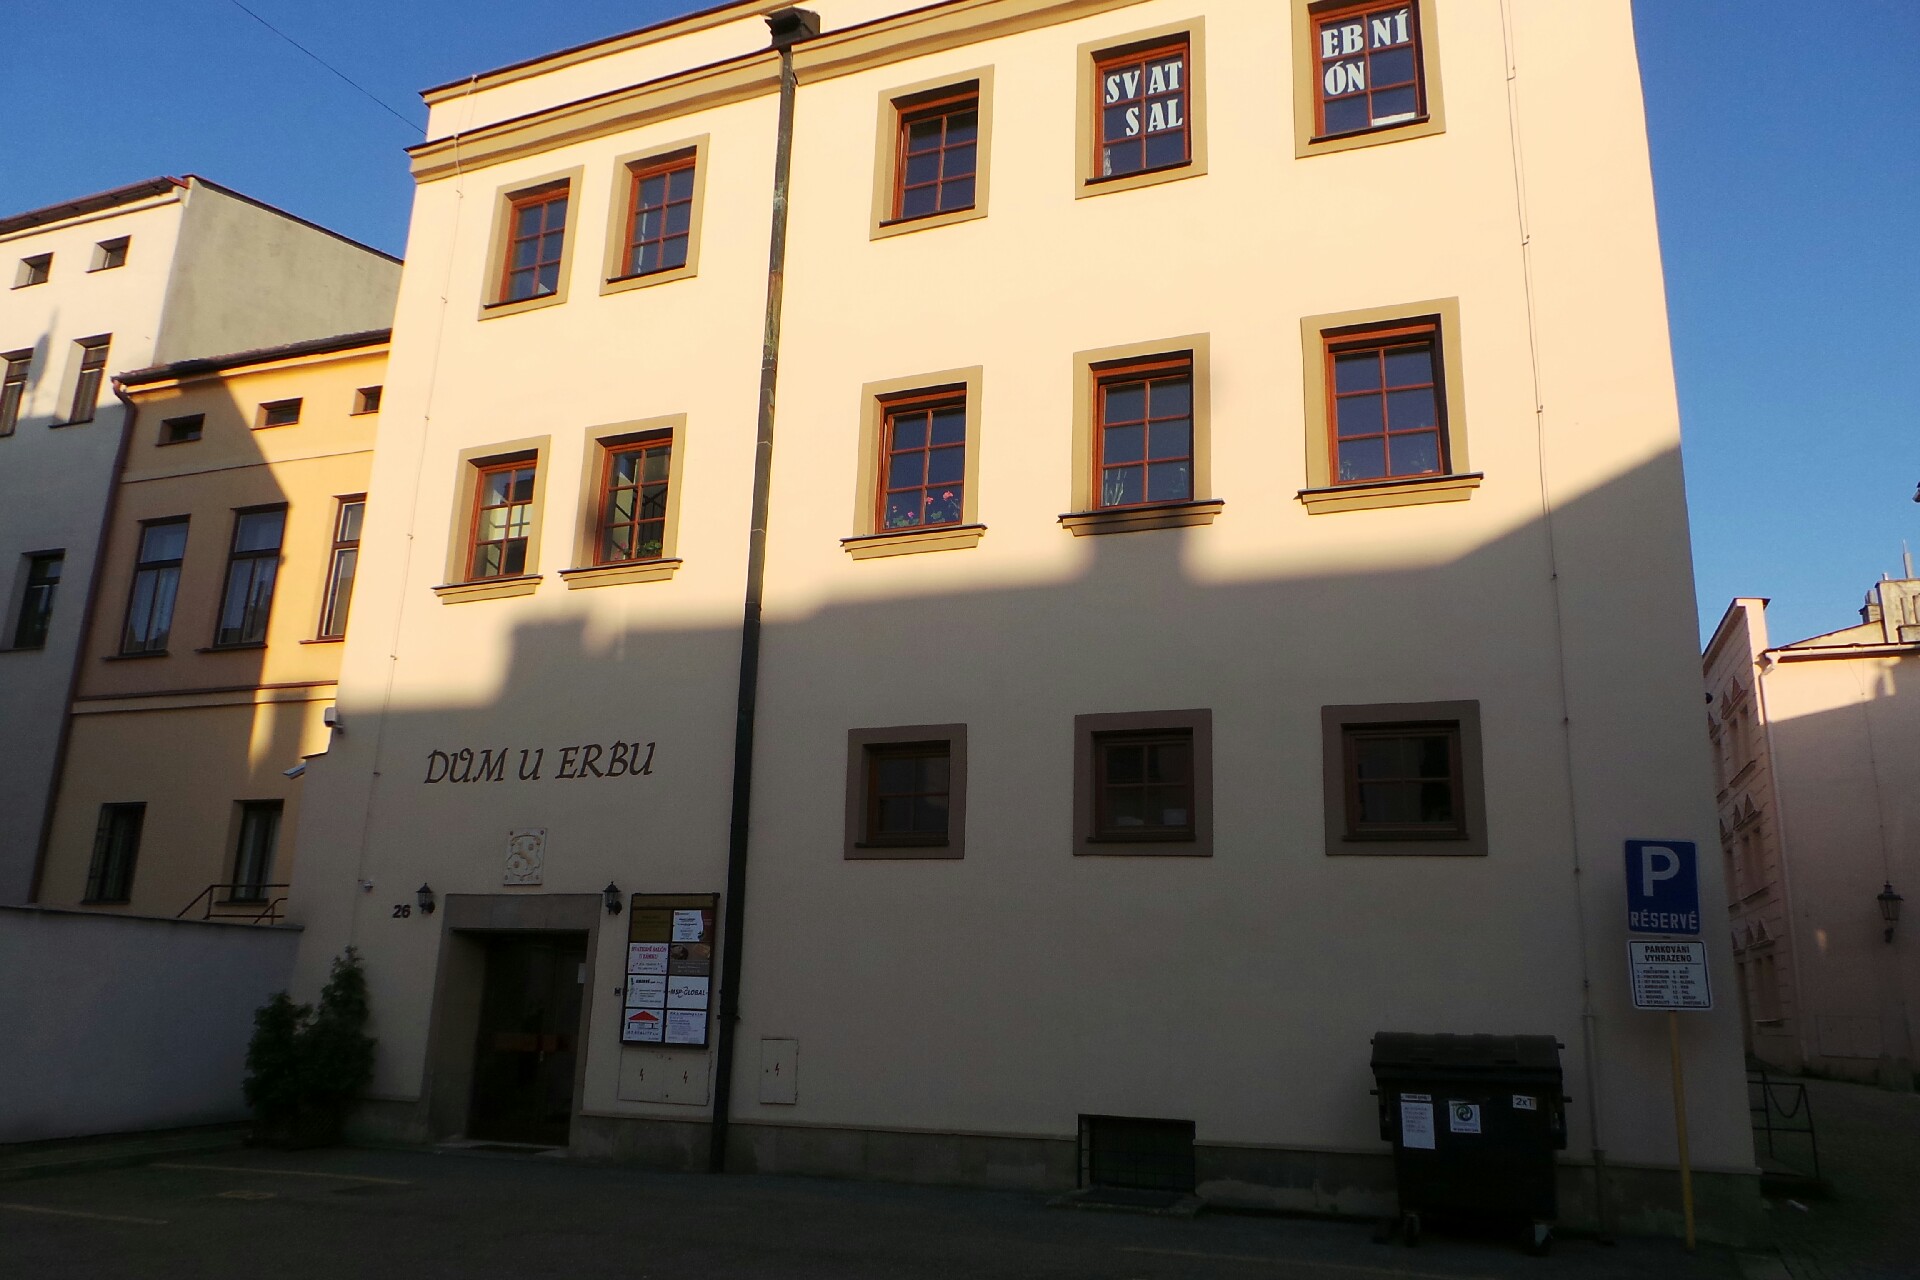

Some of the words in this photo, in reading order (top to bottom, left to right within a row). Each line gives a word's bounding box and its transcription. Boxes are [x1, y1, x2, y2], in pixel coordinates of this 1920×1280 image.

[424, 748, 509, 784] DŮM
[519, 748, 544, 781] U
[555, 740, 656, 779] ERBU
[1641, 846, 1681, 897] P
[393, 904, 411, 919] 26
[1630, 909, 1698, 930] RÉSERVÉ
[1645, 954, 1692, 963] VYHRAZENO
[683, 987, 705, 996] GLOBAL
[1515, 1097, 1534, 1107] 2xT
